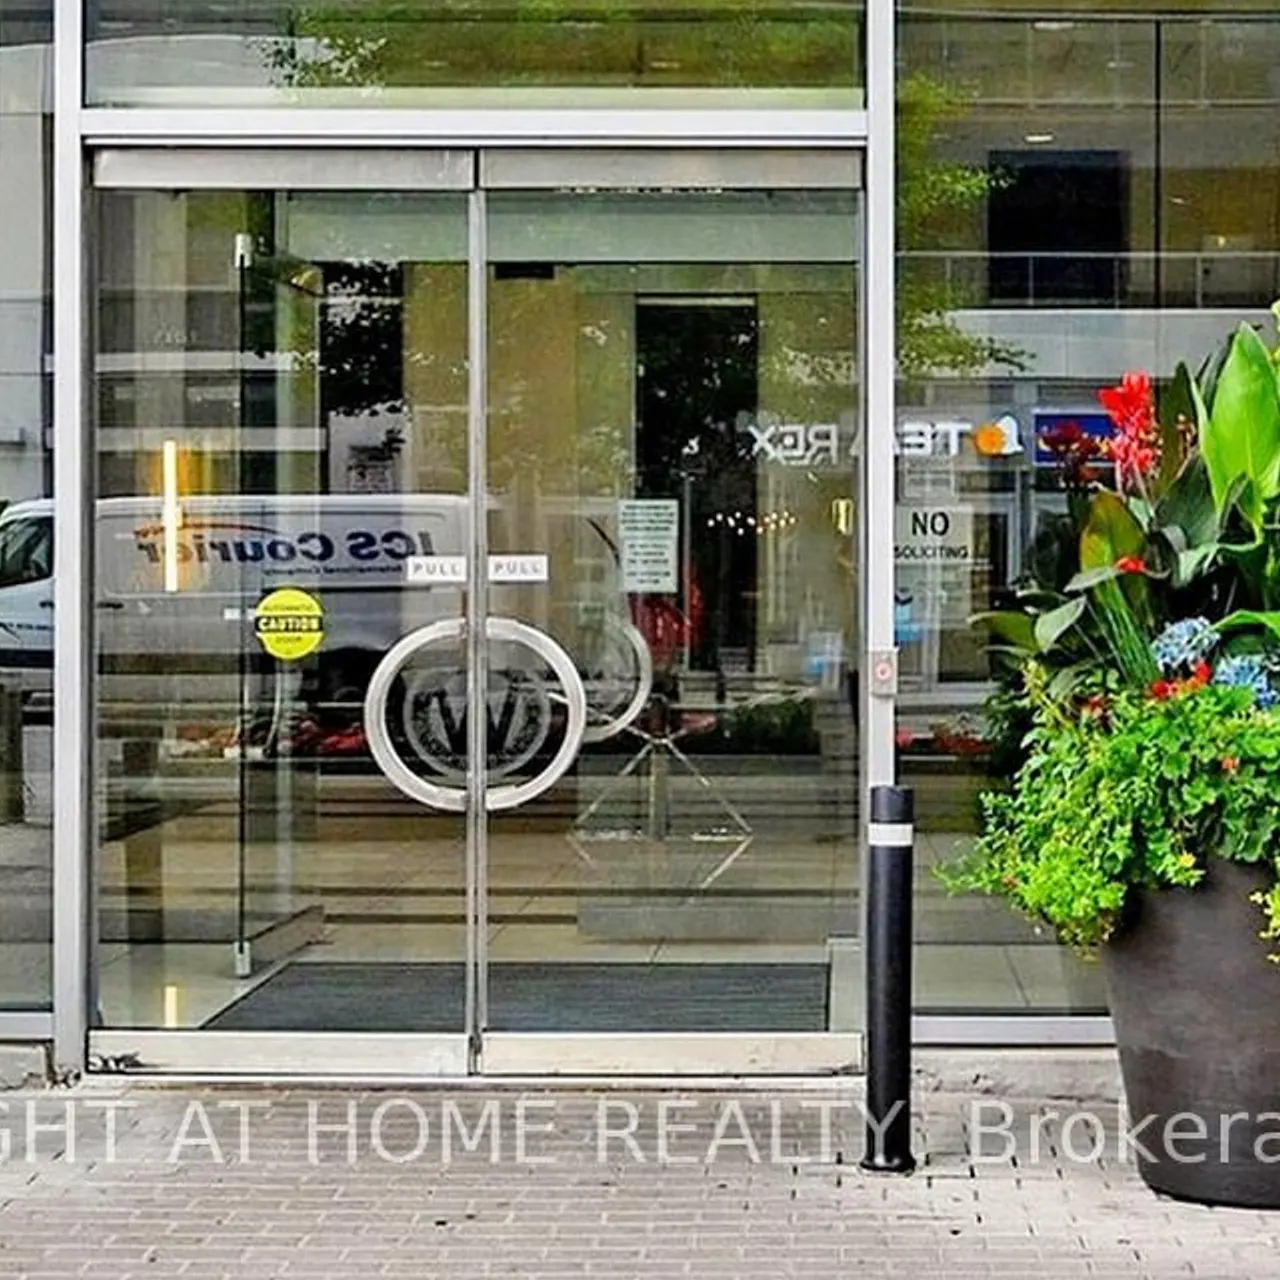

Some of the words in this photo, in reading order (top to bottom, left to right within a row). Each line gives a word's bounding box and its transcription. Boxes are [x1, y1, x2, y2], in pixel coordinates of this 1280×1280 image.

[912, 511, 950, 536] NO
[413, 562, 460, 576] PULL
[494, 561, 541, 575] PULL
[257, 616, 320, 631] CAUTION
